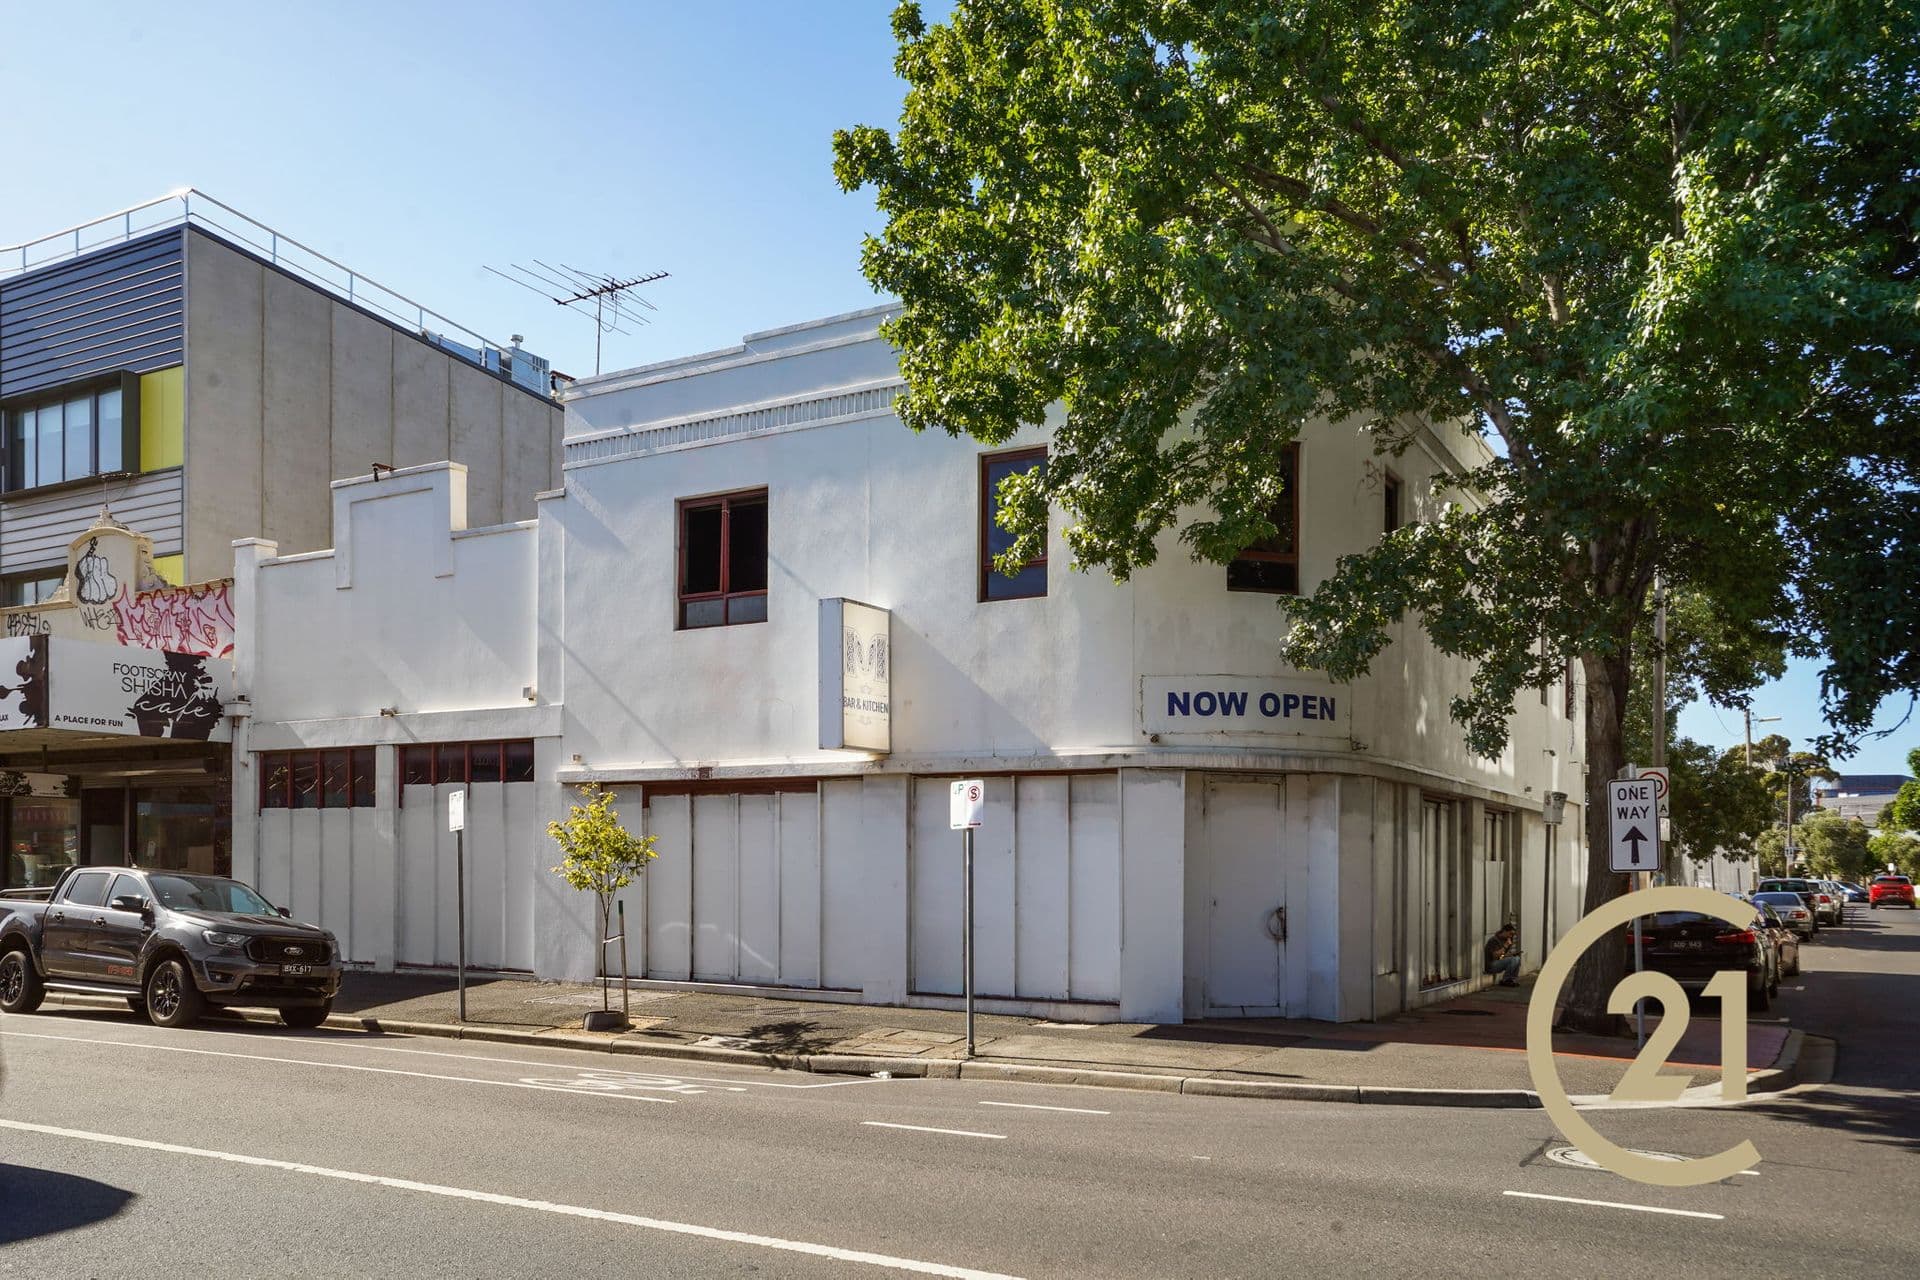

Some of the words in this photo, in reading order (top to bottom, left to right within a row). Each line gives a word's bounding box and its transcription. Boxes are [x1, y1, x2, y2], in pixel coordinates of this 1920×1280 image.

[113, 663, 187, 683] FOOTSCRAY
[121, 677, 188, 699] SHISHA
[842, 696, 856, 710] BAR
[863, 699, 889, 714] KITCHEN
[1167, 691, 1249, 717] NOW
[1258, 692, 1336, 721] OPEN
[55, 714, 62, 722] A
[63, 715, 89, 724] PLACE
[90, 717, 106, 726] FOR
[108, 719, 124, 727] FUN
[1617, 786, 1649, 801] ONE
[1616, 805, 1650, 820] WAY
